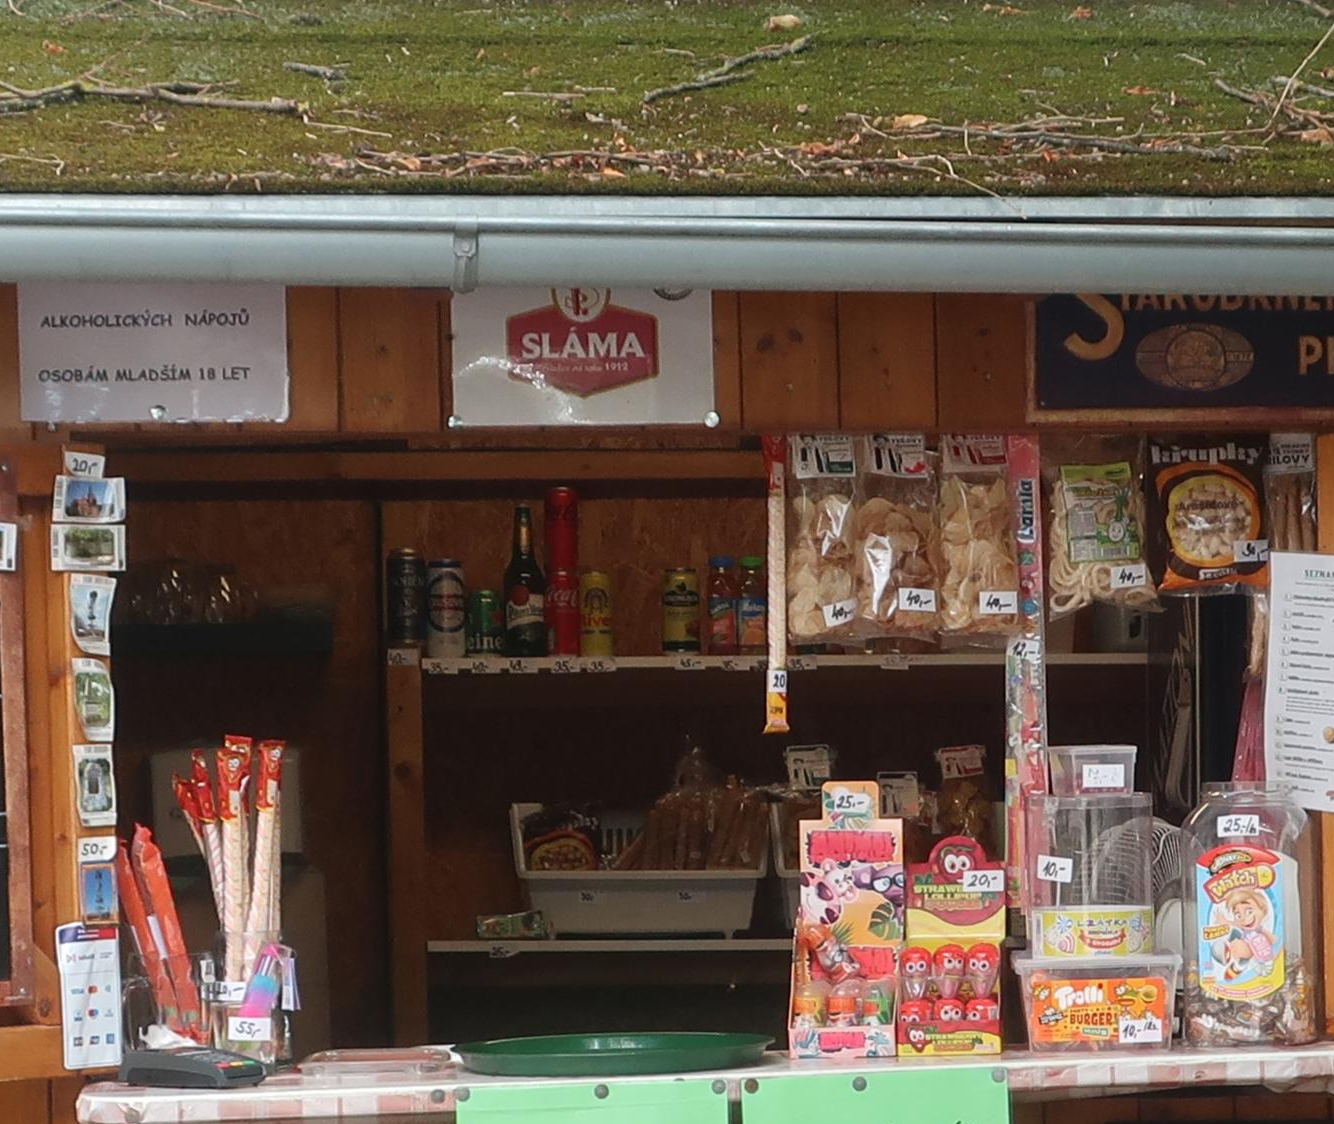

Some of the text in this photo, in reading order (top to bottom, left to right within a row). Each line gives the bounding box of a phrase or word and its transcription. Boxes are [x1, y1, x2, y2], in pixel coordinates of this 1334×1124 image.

[41, 310, 250, 329] ALKOHOLICKÝCH NÁPOJŮ
[522, 326, 645, 360] SLÁMA
[38, 364, 250, 383] OSOBÁM MLADŠÍM 18 LET
